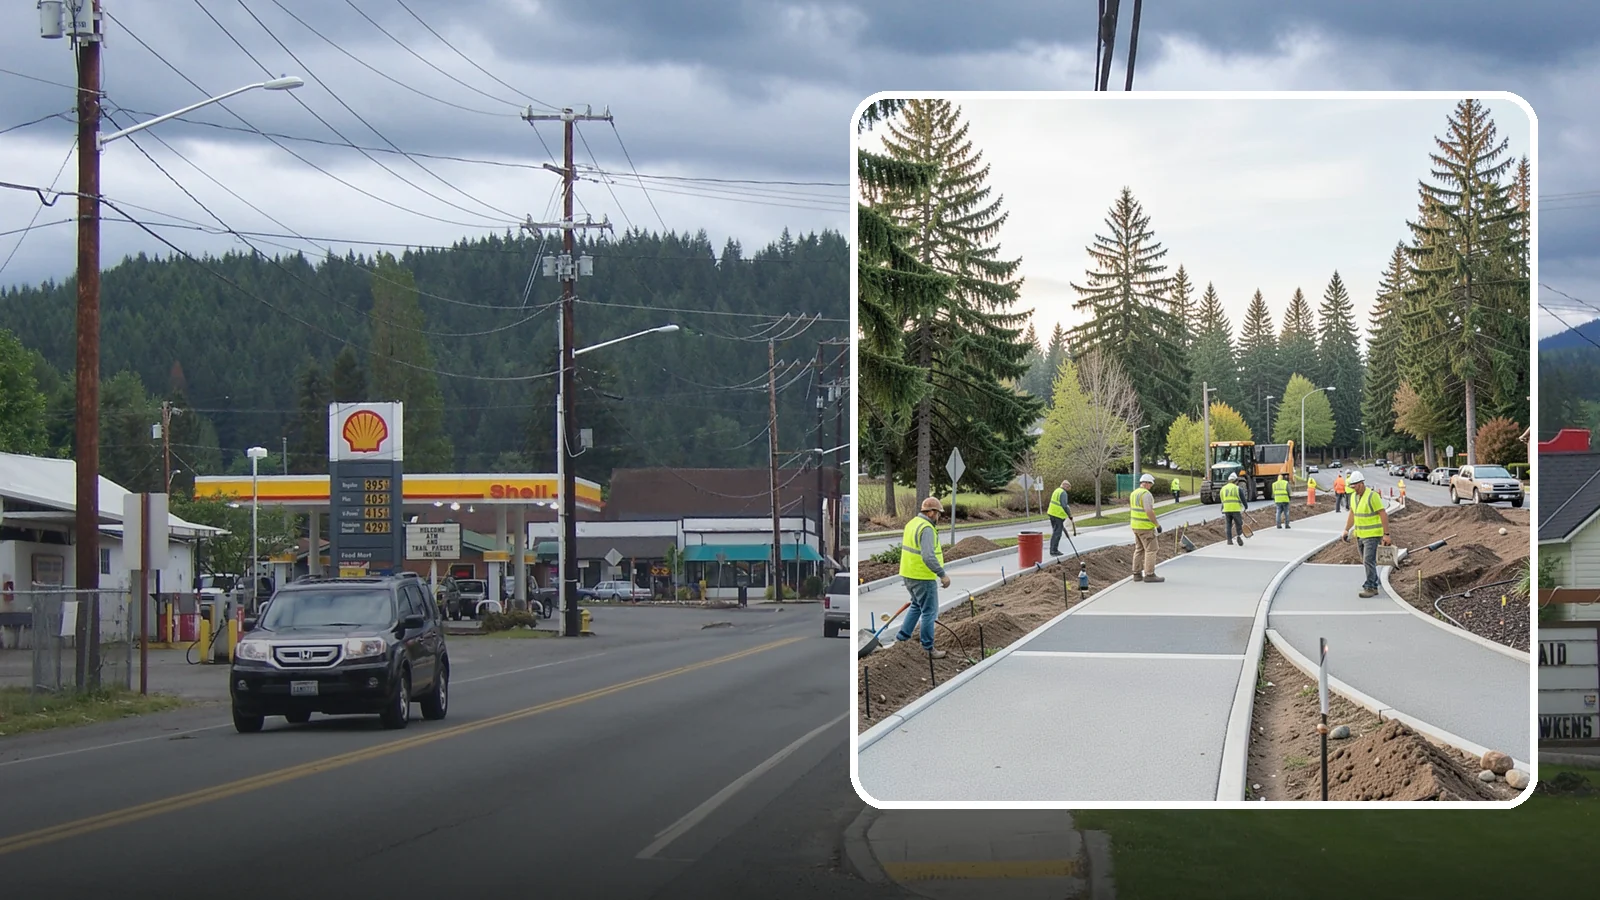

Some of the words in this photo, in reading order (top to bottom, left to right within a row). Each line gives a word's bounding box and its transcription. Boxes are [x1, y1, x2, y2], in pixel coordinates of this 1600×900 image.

[366, 480, 384, 490] 395
[490, 484, 548, 499] Shell
[365, 494, 384, 504] 405
[365, 508, 384, 518] 415
[365, 522, 384, 532] 429
